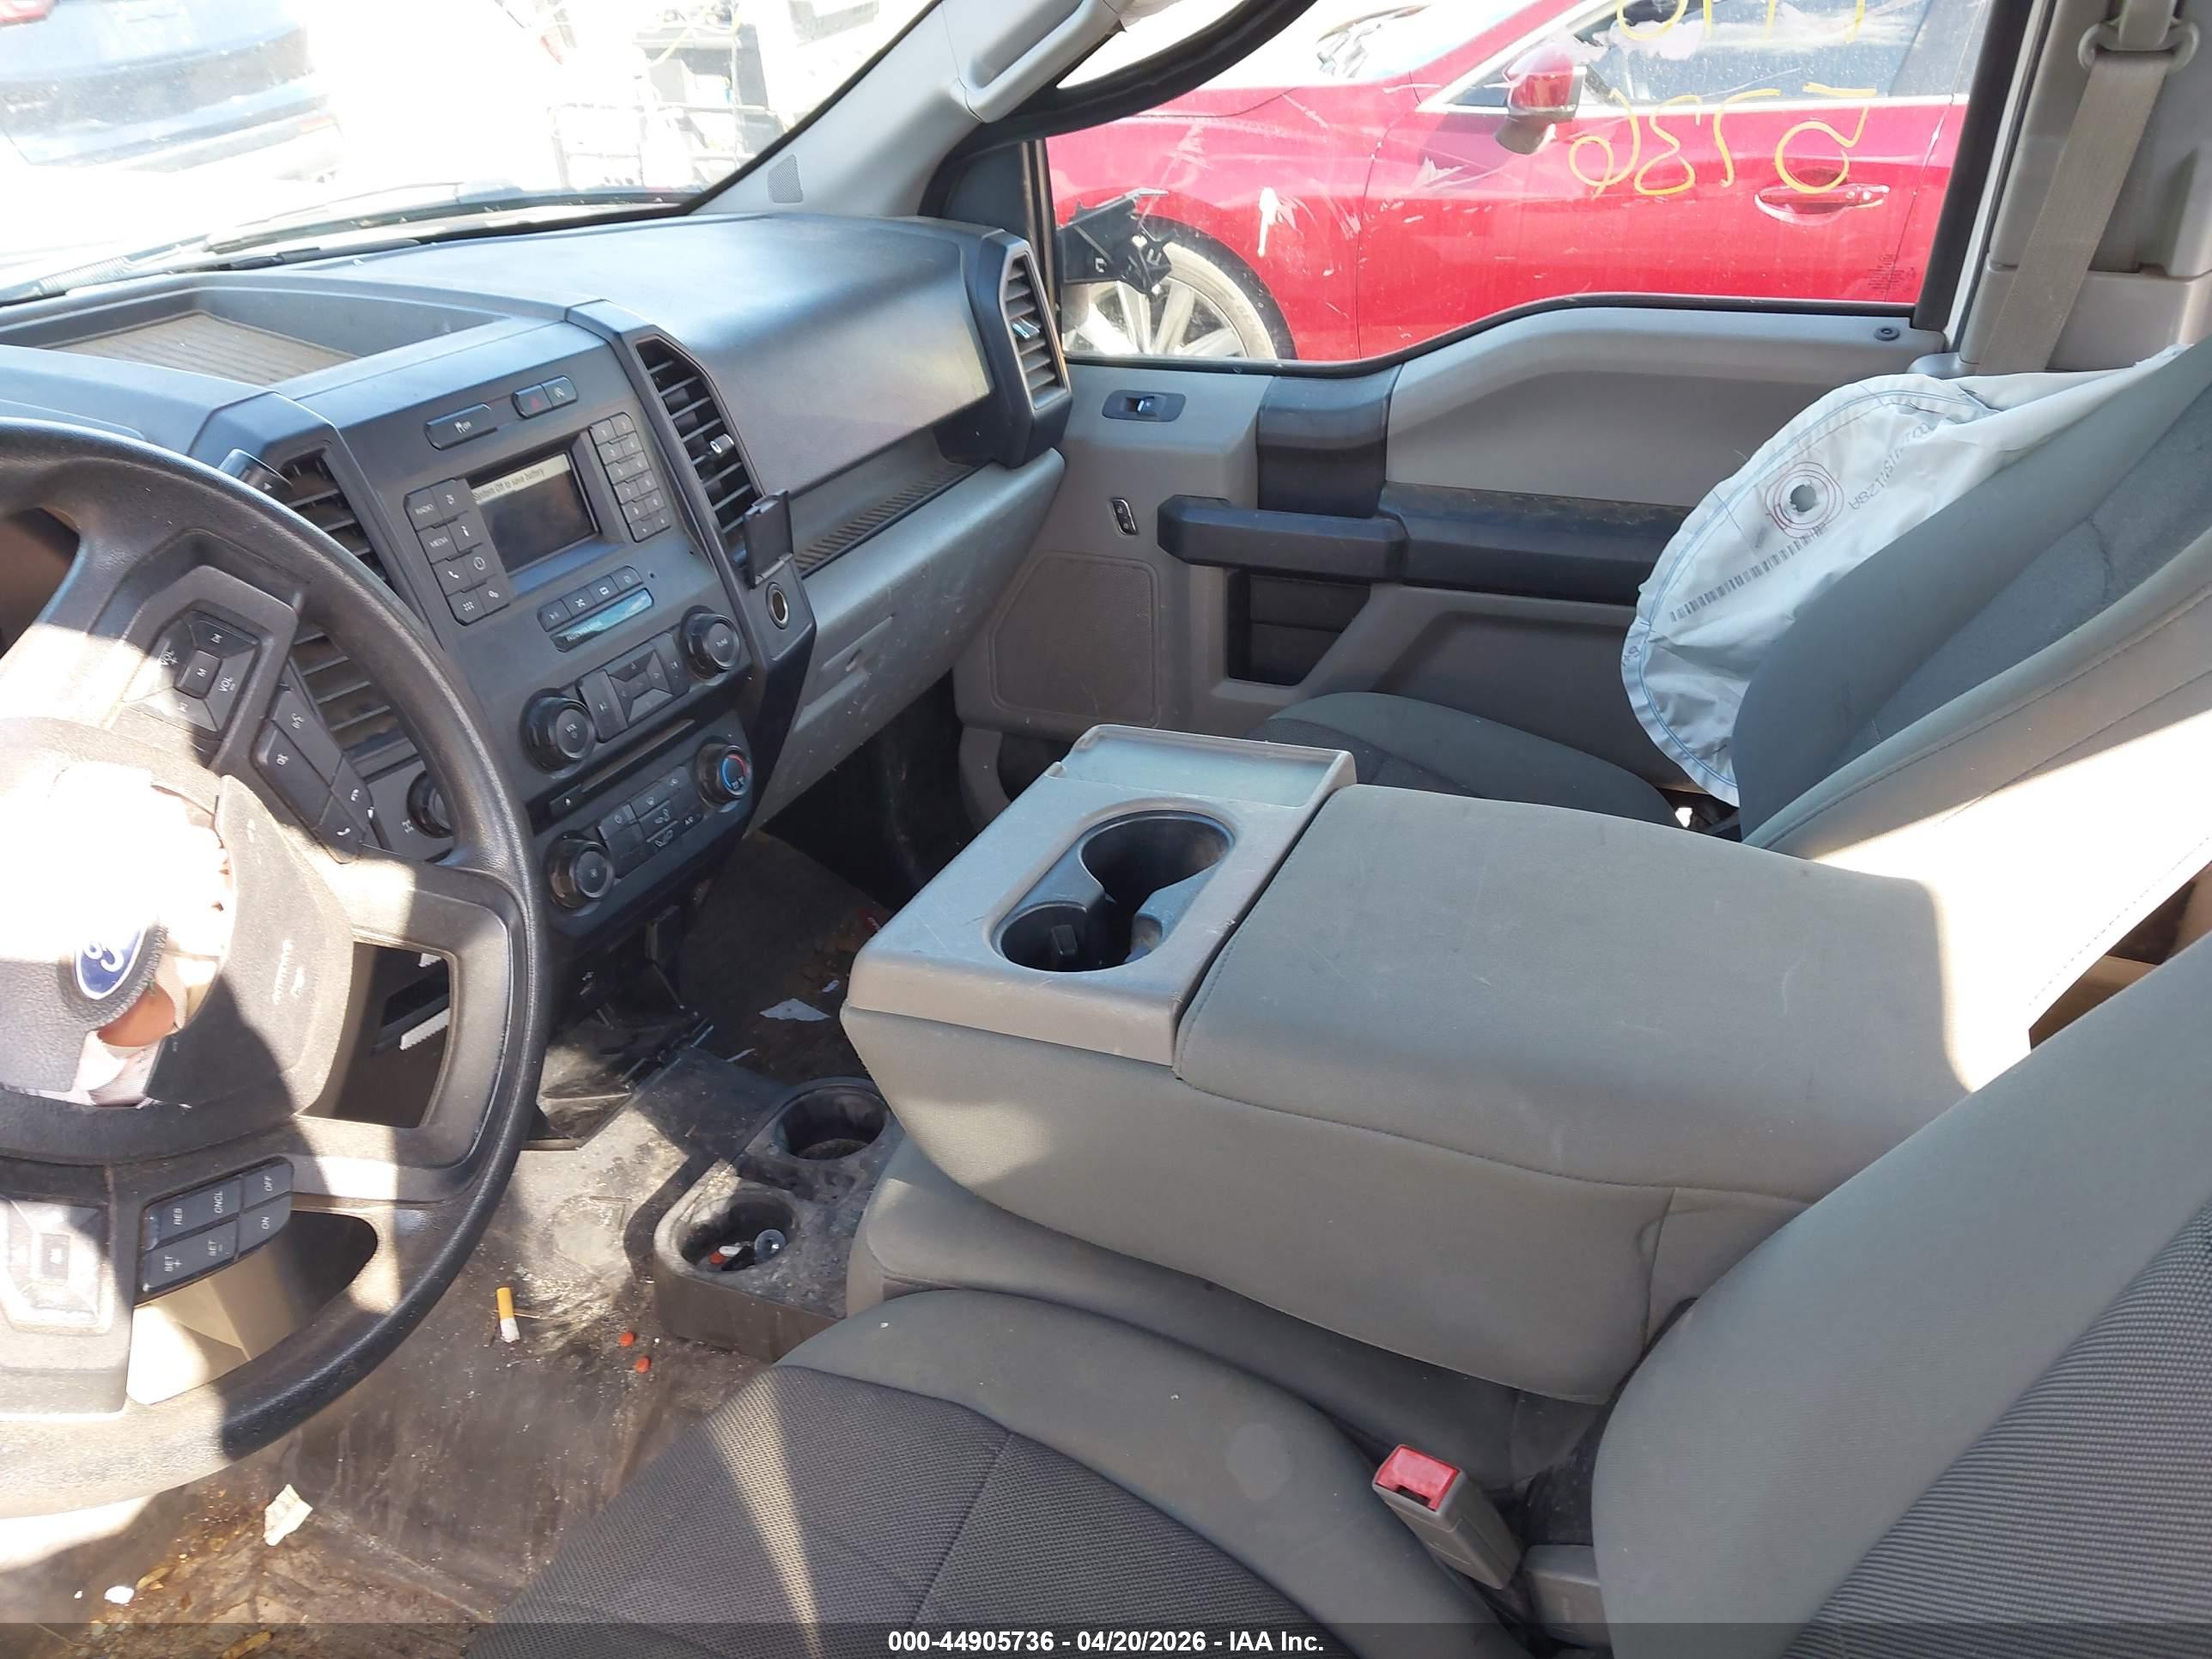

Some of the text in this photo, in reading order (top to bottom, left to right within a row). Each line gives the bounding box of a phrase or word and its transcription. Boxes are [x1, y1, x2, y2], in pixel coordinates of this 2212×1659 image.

[161, 650, 175, 666] VOL
[218, 676, 234, 692] VOL
[263, 1175, 274, 1192] OFF
[260, 1216, 270, 1230] ON
